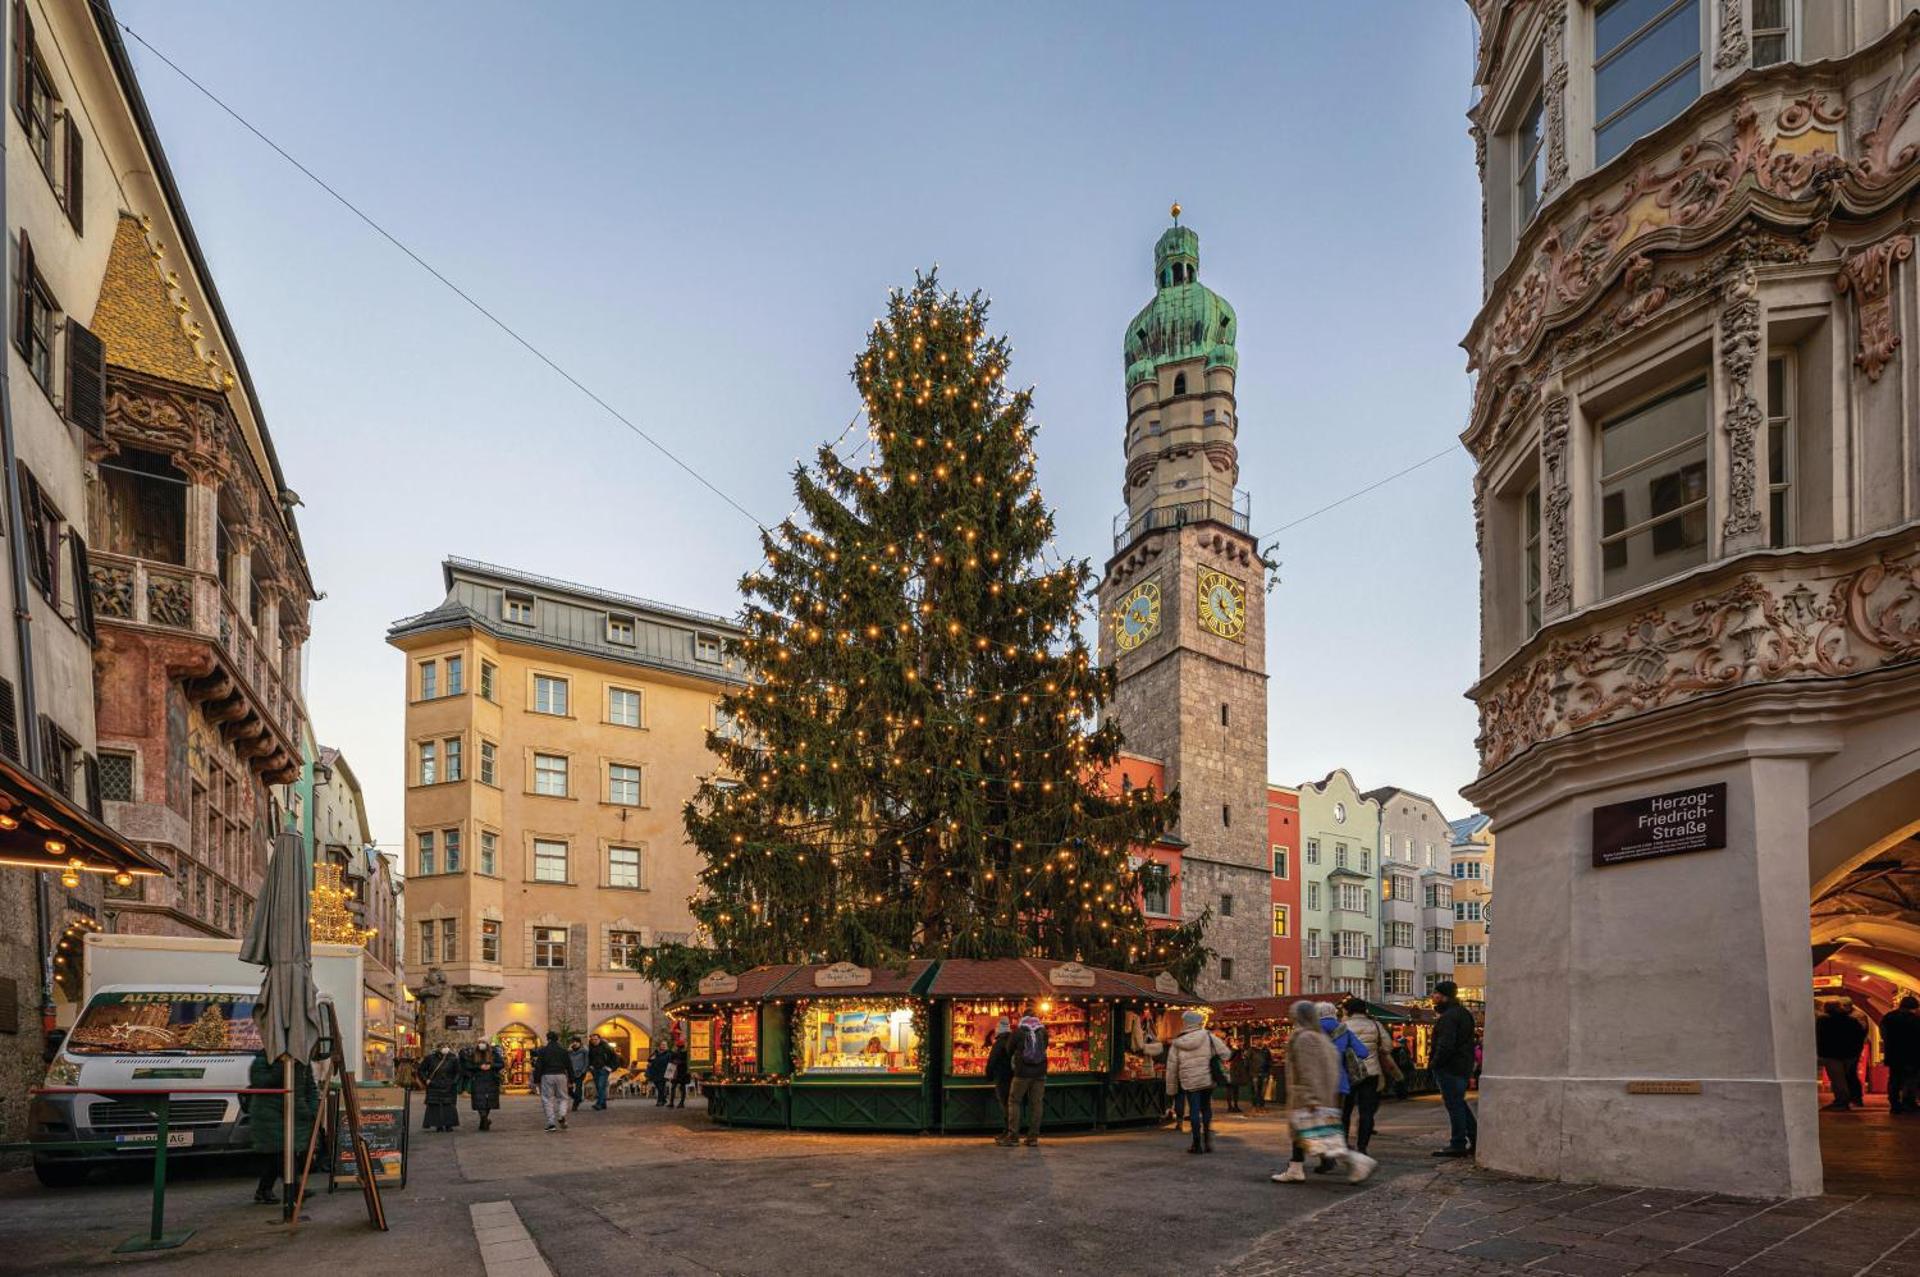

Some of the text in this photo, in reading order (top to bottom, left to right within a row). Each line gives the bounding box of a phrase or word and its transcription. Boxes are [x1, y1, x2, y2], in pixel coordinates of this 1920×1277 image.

[1651, 792, 1714, 812] Herzog-
[1638, 806, 1714, 829] Friedrich-
[1652, 821, 1706, 840] Straße
